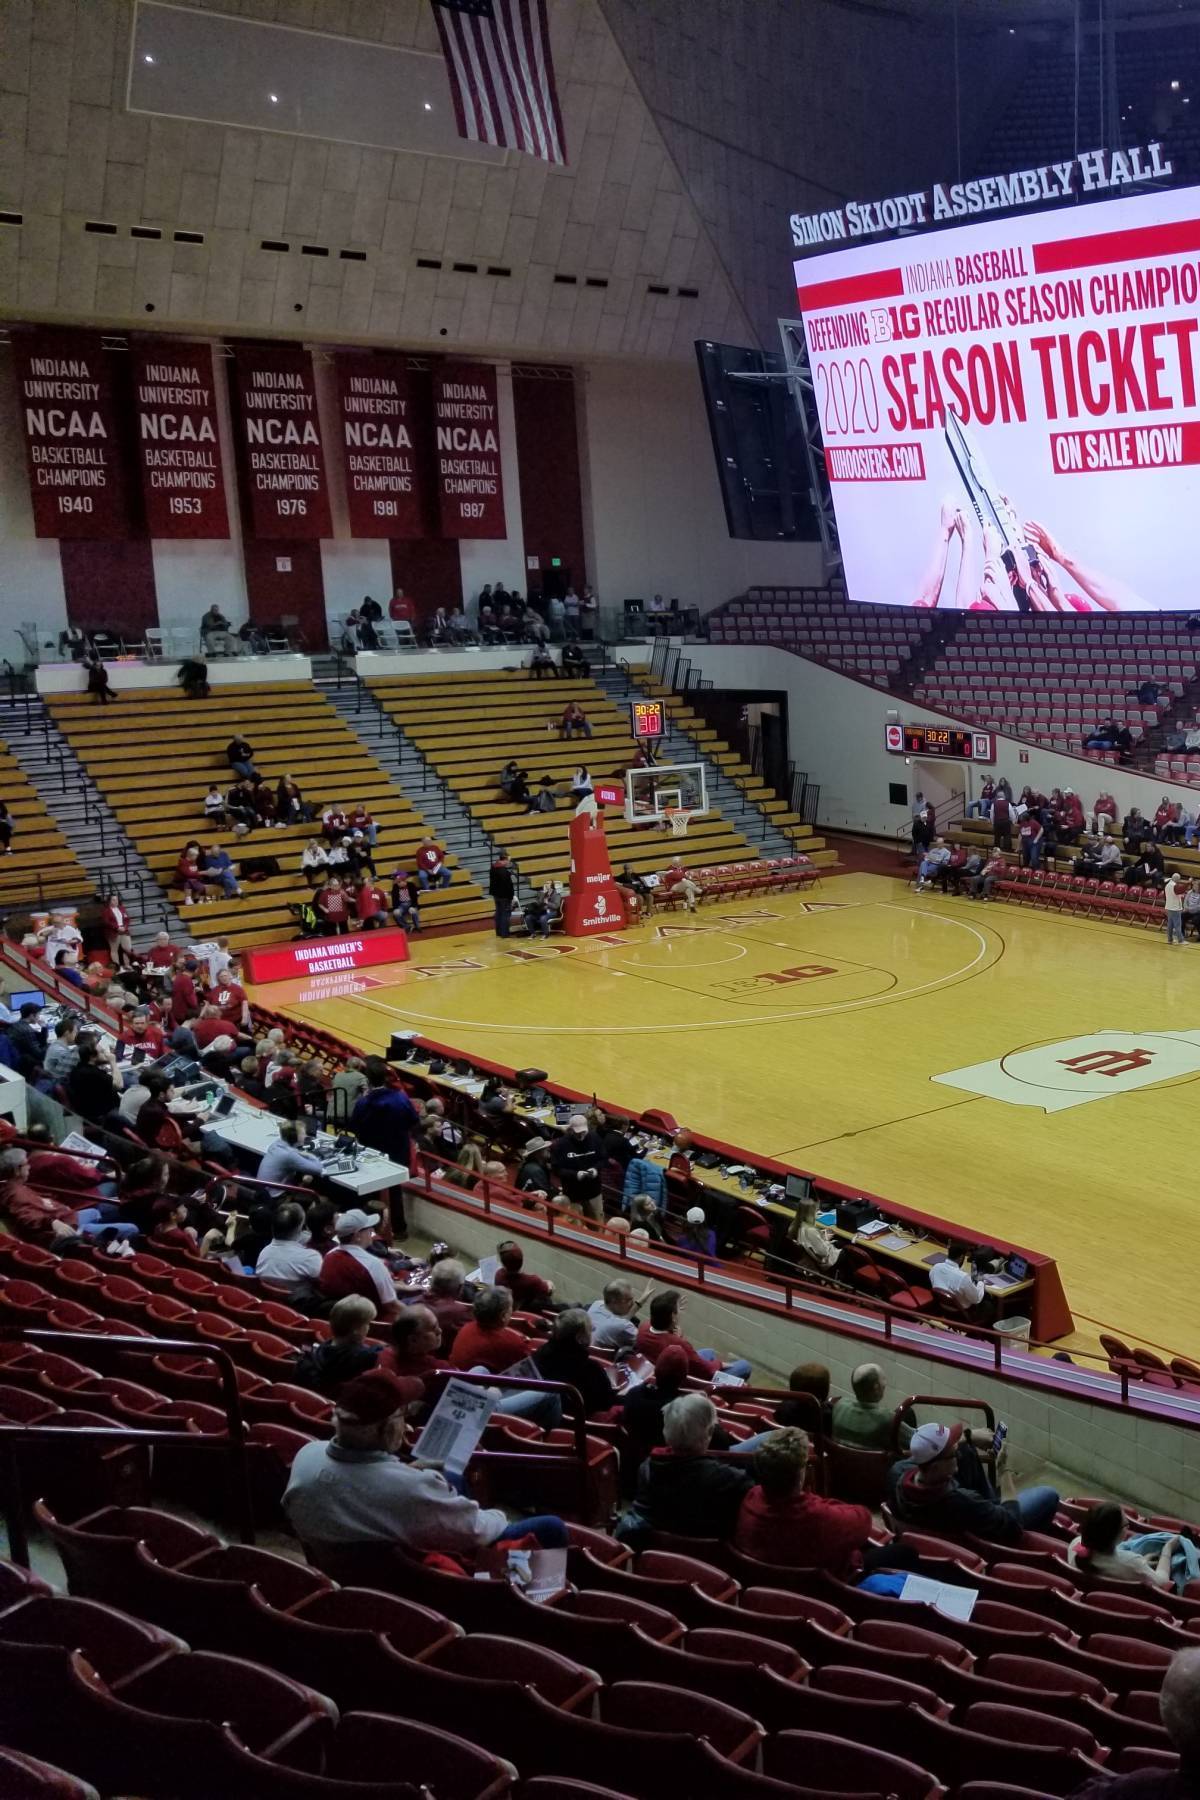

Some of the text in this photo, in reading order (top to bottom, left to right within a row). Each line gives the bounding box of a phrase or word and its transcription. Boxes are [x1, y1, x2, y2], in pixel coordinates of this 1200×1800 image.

[789, 141, 1173, 247] SIMON SKJODT ASSEMBLY HALL
[905, 246, 1029, 294] INDIANA BASEBALL
[807, 311, 871, 353] DEFENDING
[924, 289, 1003, 338] REGULAR
[1005, 278, 1085, 327] SEASON
[30, 357, 90, 378] INDIANA
[146, 364, 200, 384] INDIANA
[252, 371, 304, 389] INDIANA
[350, 376, 398, 395] INDIANA
[816, 357, 881, 436] 2020
[881, 339, 1028, 432] SEASON
[24, 380, 100, 400] UNIVERSITY
[139, 386, 209, 406] UNIVERSITY
[442, 383, 487, 401] INDIANA
[246, 392, 313, 411] UNIVERSITY
[344, 396, 406, 416] UNIVERSITY
[437, 402, 494, 420] UNIVERSITY
[26, 408, 108, 438] NCAA
[140, 412, 216, 442] NCAA
[246, 418, 319, 445] NCAA
[345, 421, 412, 448] NCAA
[437, 426, 498, 452] NCAA
[32, 445, 108, 465] BASKETBALL
[1056, 427, 1183, 471] ON SALE NOW
[145, 449, 217, 468] BASKETBALL
[252, 453, 320, 470] BASKETBALL
[349, 455, 413, 473] BASKETBALL
[440, 459, 498, 476] BASKETBALL
[831, 447, 922, 479] IUHOOSIERS.COM
[37, 468, 106, 486] CHAMPIONS
[151, 471, 216, 489] CHAMPIONS
[256, 474, 319, 490] CHAMPIONS
[353, 475, 412, 492] CHAMPIONS
[444, 478, 497, 494] CHAMPIONS
[58, 496, 93, 513] 1940
[169, 497, 202, 514] 1953
[277, 499, 307, 515] 1976
[373, 500, 397, 515] 1981
[460, 502, 485, 518] 1987
[635, 704, 660, 715] 30:22
[640, 715, 658, 732] 30
[586, 873, 611, 883] meijer
[583, 914, 621, 926] Smithville
[294, 941, 363, 961] INDIANA WOMEN'S
[309, 956, 355, 973] BASKETBALL
